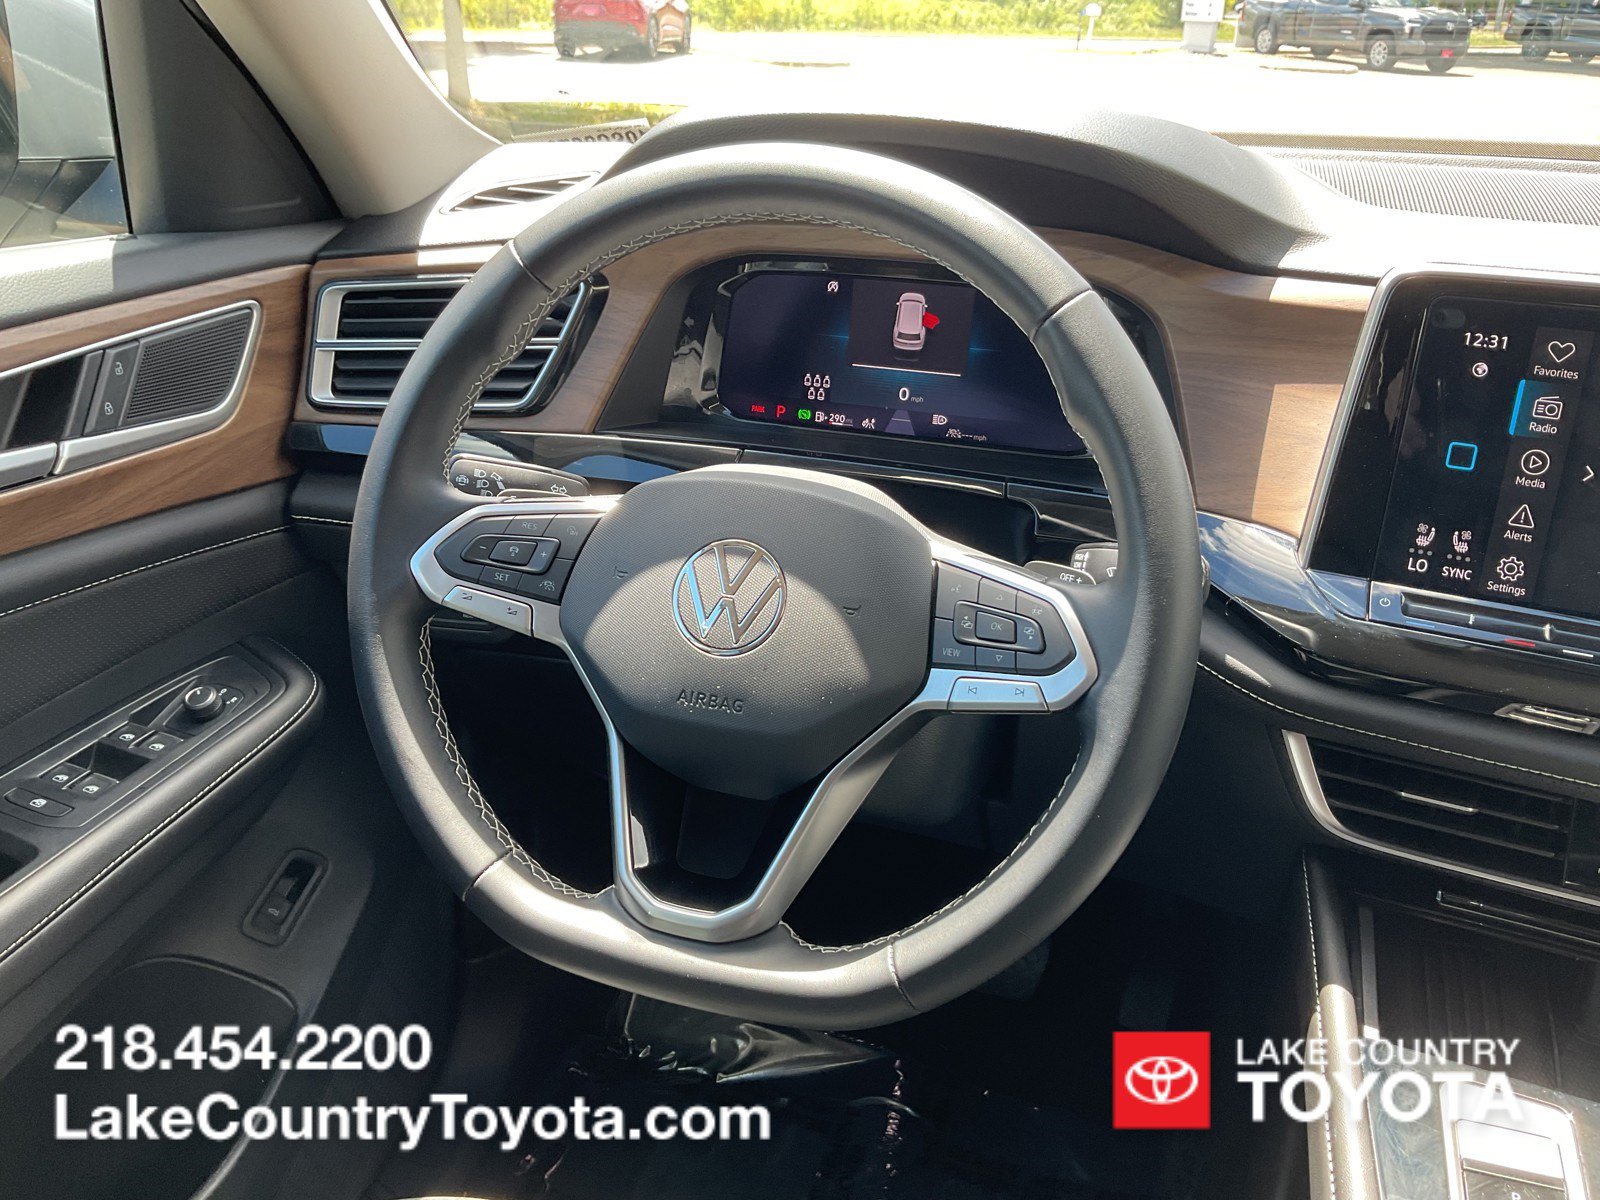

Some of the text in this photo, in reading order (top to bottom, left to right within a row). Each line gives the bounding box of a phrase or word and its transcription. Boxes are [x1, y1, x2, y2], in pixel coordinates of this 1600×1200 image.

[1463, 331, 1509, 350] 12:31
[1533, 364, 1579, 380] Favorites
[898, 387, 909, 401] 0
[751, 404, 765, 413] PARK
[776, 404, 786, 418] P
[829, 413, 846, 423] 290
[1528, 421, 1558, 435] Radio
[1515, 475, 1546, 489] Media
[521, 521, 538, 532] RES
[1503, 529, 1533, 543] Alerts
[1407, 557, 1428, 573] LO
[494, 572, 510, 583] SET
[1060, 572, 1075, 583] OFF
[1441, 565, 1473, 581] SYNC
[1486, 580, 1526, 597] Settings
[990, 622, 1003, 631] OK
[942, 647, 961, 657] VIEW
[676, 688, 744, 713] AIRBAG
